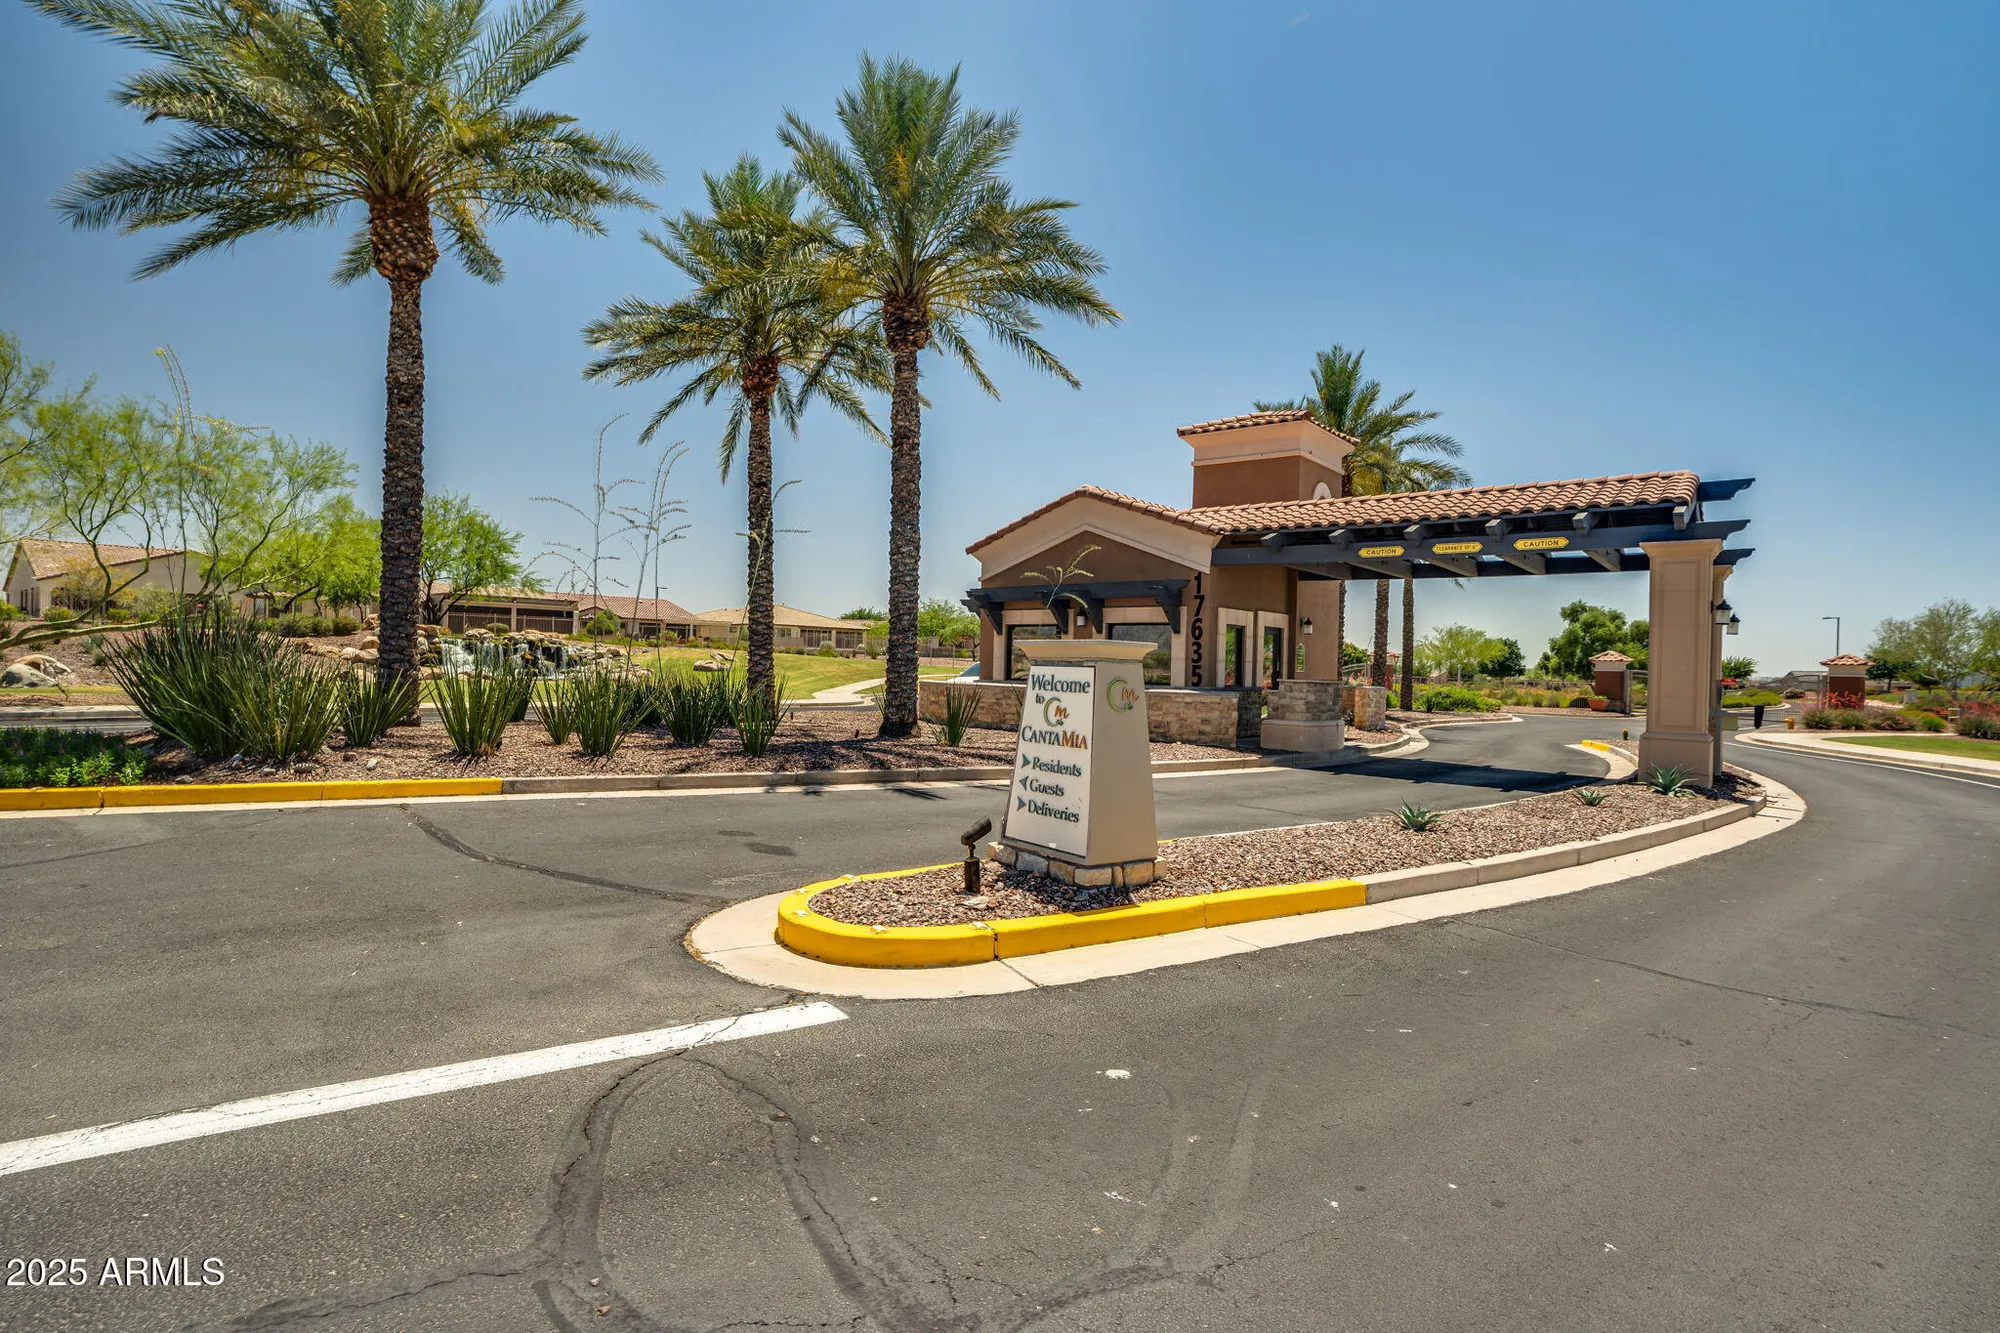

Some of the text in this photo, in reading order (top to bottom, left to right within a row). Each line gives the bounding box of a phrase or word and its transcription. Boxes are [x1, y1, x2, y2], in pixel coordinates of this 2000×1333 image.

[1366, 548, 1397, 556] CAUTION
[1523, 539, 1559, 548] CAUTION
[1191, 571, 1205, 687] 17635
[1031, 674, 1090, 694] Welcome
[1035, 693, 1045, 704] to
[1032, 756, 1082, 777] Residents
[1029, 779, 1065, 797] Guests
[1027, 799, 1080, 823] Deliveries
